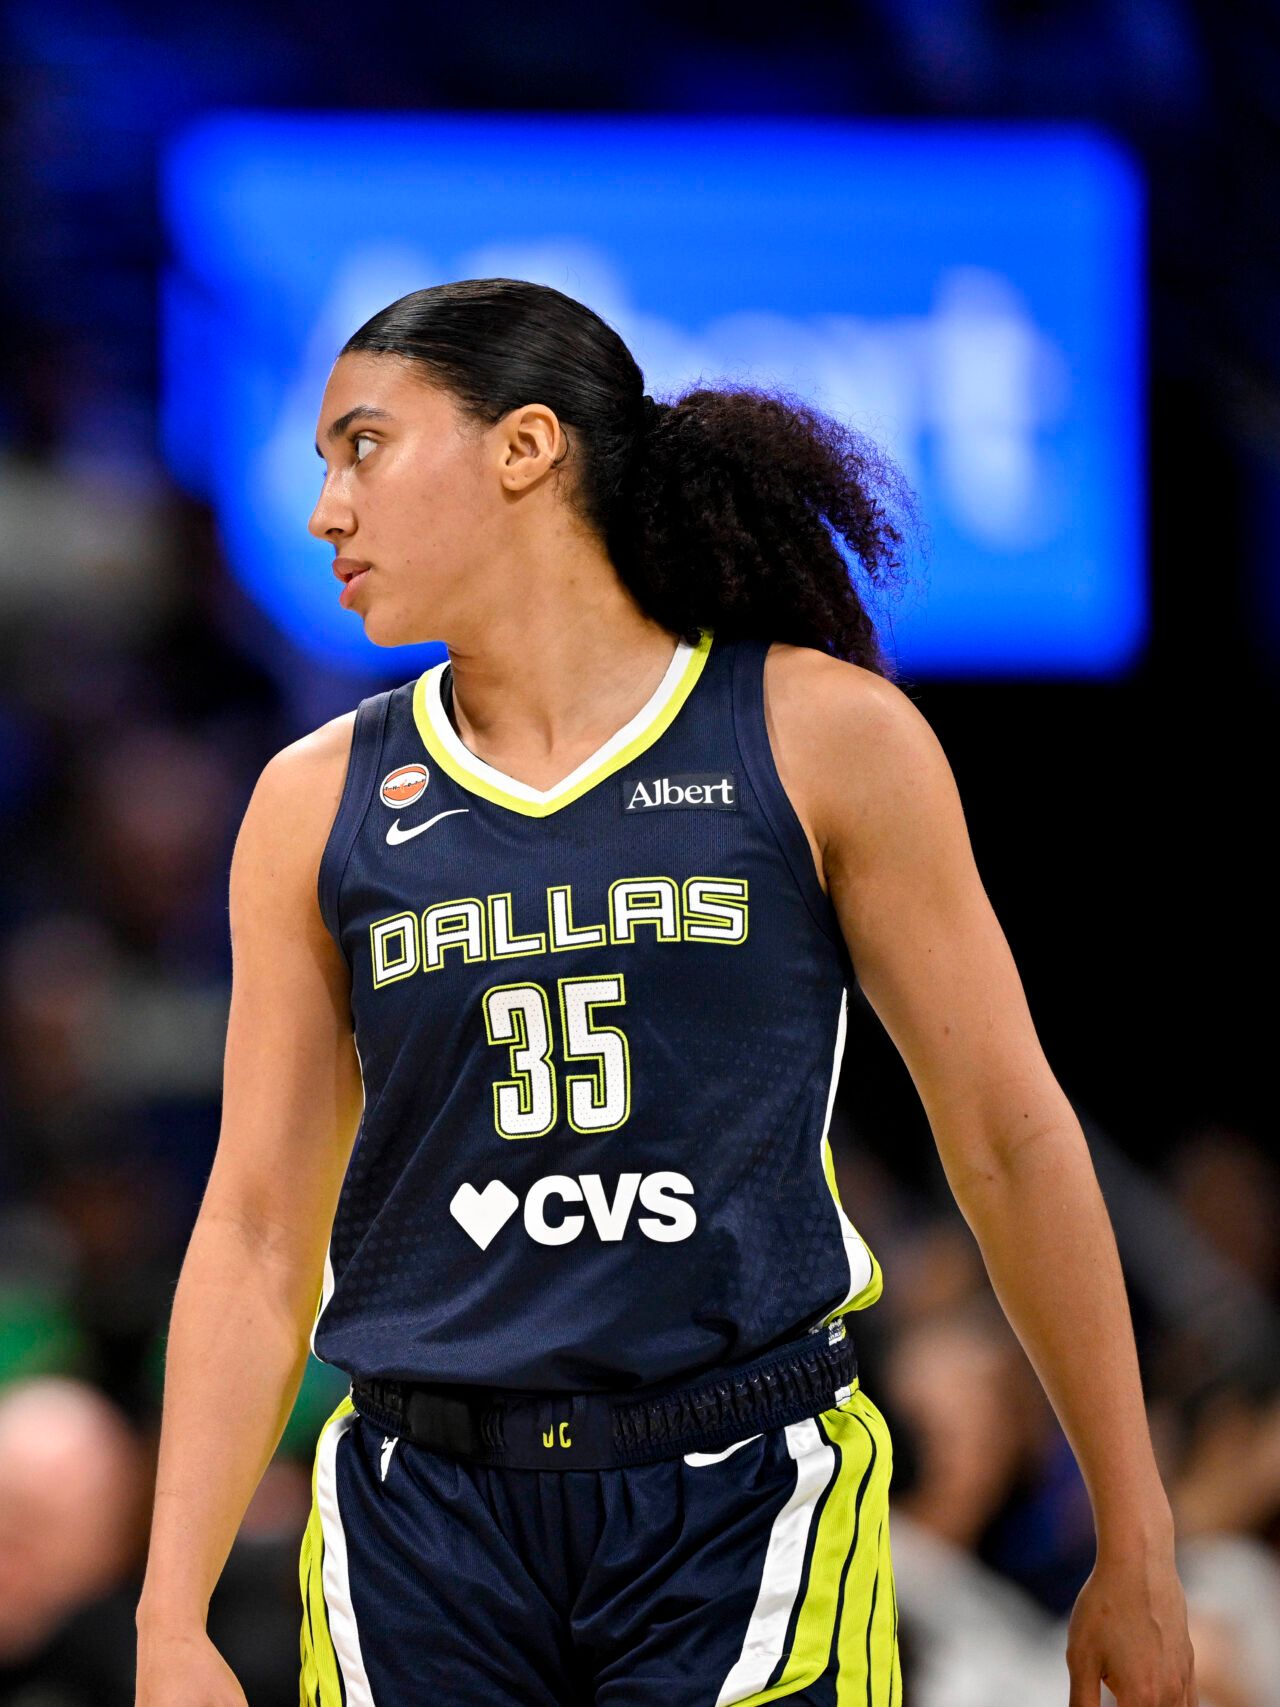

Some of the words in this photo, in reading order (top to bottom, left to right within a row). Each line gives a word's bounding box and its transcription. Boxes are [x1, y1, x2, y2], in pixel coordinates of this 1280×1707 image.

[627, 778, 734, 809] Albert
[369, 876, 749, 990] DALLAS
[481, 973, 631, 1140] 35
[523, 1171, 697, 1246] CVS
